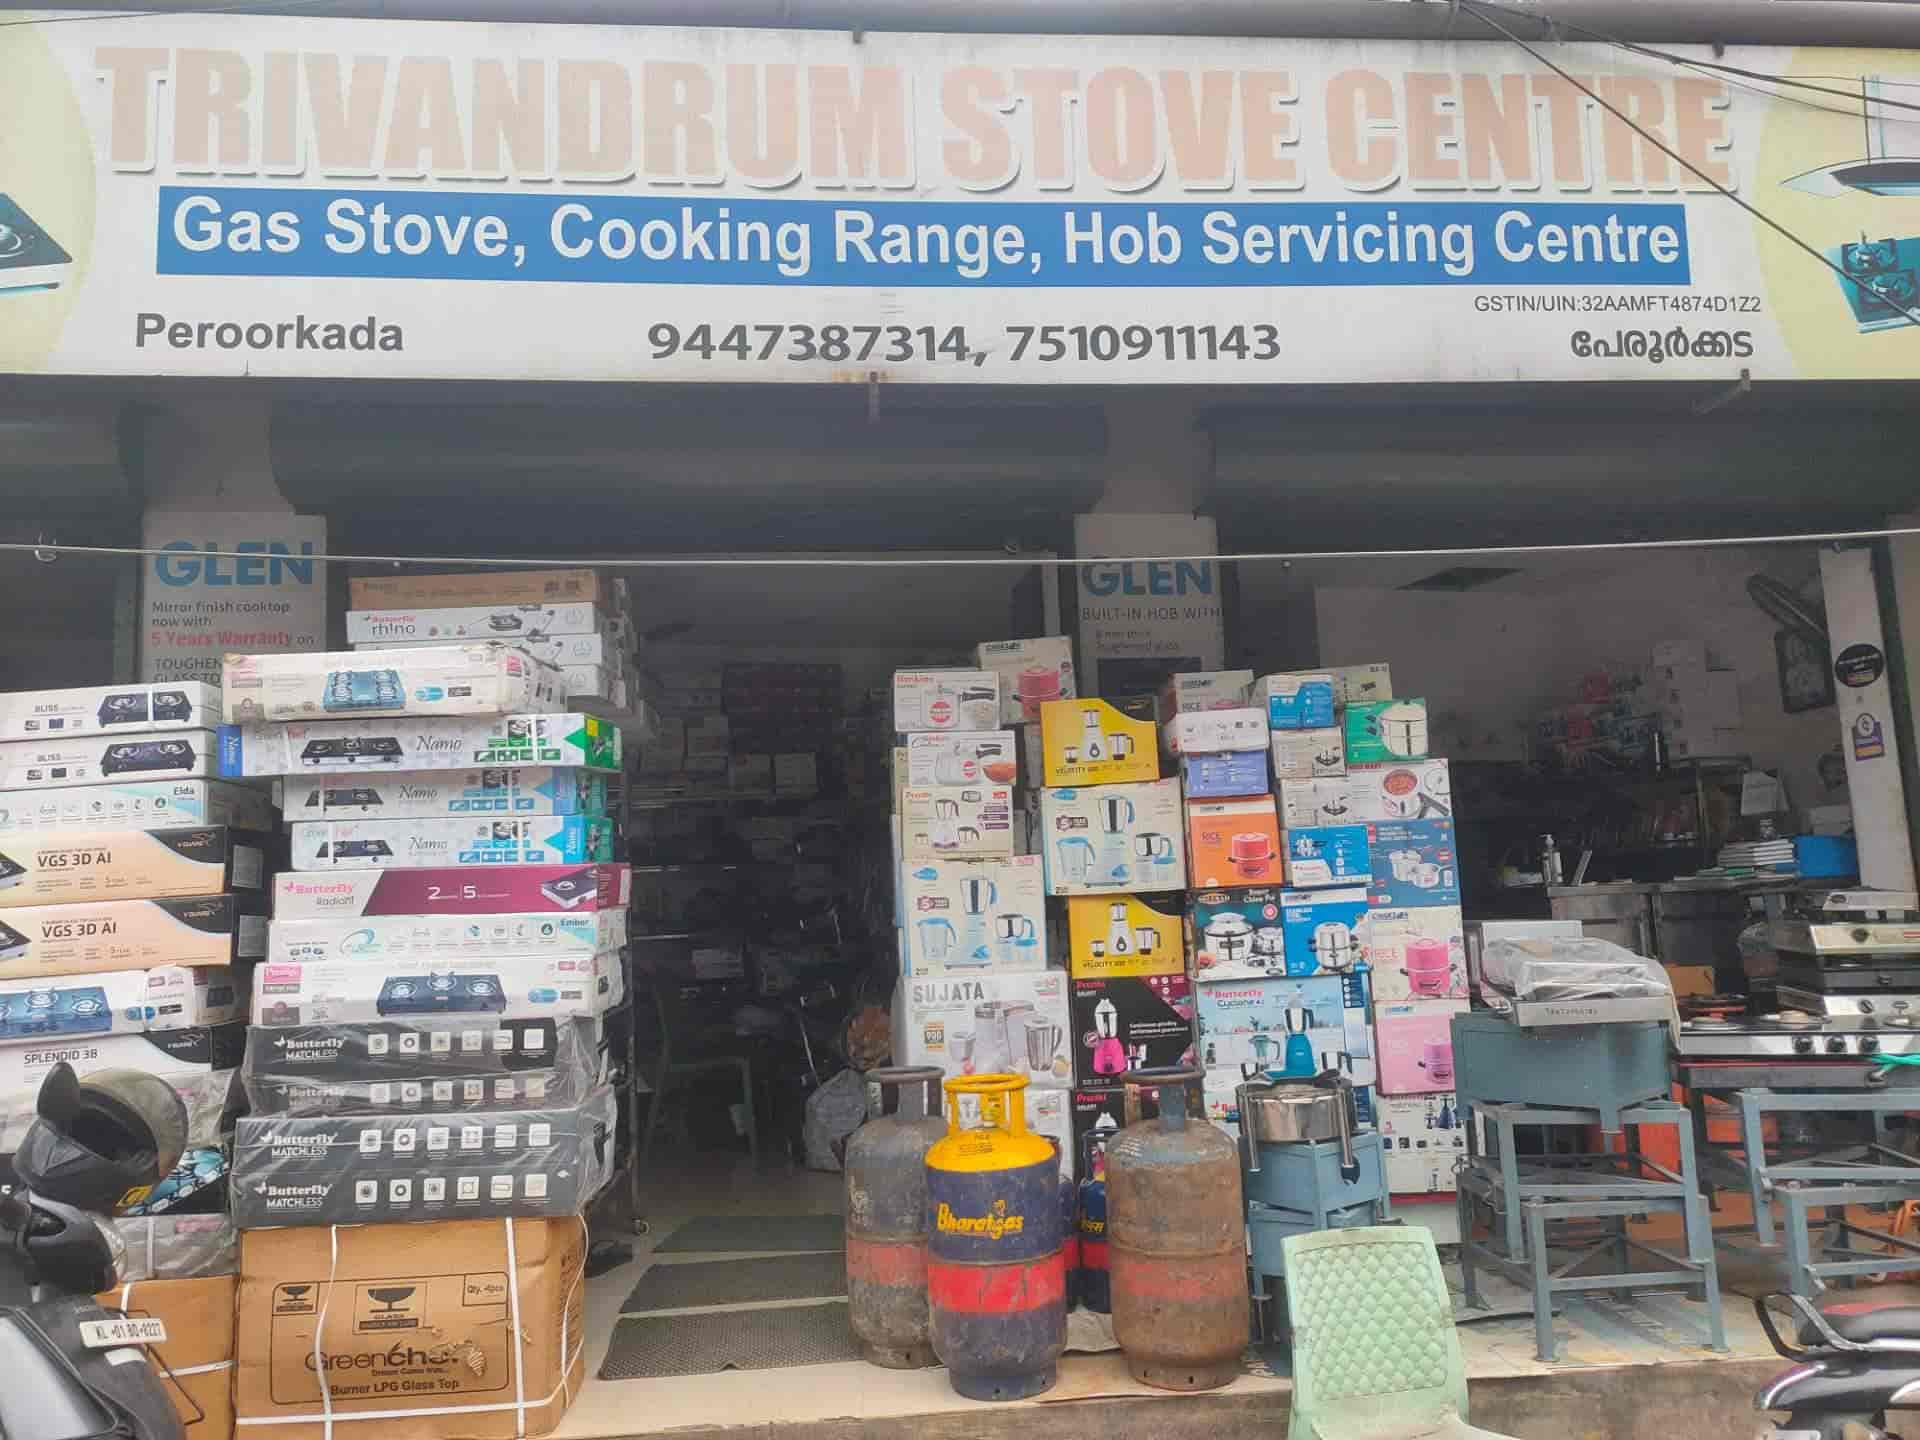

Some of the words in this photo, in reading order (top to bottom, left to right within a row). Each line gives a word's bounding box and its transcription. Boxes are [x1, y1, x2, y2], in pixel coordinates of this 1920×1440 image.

[95, 46, 918, 190] TRIVANDRUM
[940, 62, 1306, 193] STOVE
[1325, 66, 1740, 195] CENTRE
[172, 196, 301, 254] Gas
[324, 199, 527, 267] Stove,
[549, 203, 812, 276] Cooking
[834, 207, 1043, 281] Range,
[1064, 210, 1182, 264] Hob
[1202, 209, 1475, 277] Servicing
[1493, 208, 1680, 266] Centre
[1474, 294, 1762, 314] GSTIN/UIN:32AAMFT4874D1Z2
[135, 313, 404, 352] Peroorkada
[647, 322, 986, 366] 9447387314,
[1006, 325, 1281, 361] 7510911143
[155, 540, 313, 587] GLEN
[1082, 555, 1212, 596] GLEN
[152, 601, 192, 613] Mirror
[196, 600, 233, 613] finish
[235, 601, 291, 615] cooktop
[1082, 608, 1142, 620] BUILT-IN
[1148, 607, 1178, 620] HOB
[371, 620, 416, 636] rhino
[166, 631, 214, 646] Years
[218, 631, 292, 650] Warranty
[297, 635, 314, 646] on
[416, 734, 462, 751] Namo
[398, 783, 440, 800] Namo
[408, 836, 448, 850] Namo
[37, 855, 67, 868] VGS
[72, 853, 91, 866] 3D
[96, 852, 112, 864] AI
[428, 886, 441, 900] 2
[463, 885, 476, 899] 5
[41, 924, 73, 938] VGS
[77, 923, 97, 936] 3D
[101, 922, 117, 935] AI
[913, 982, 985, 1003] SUJATA
[286, 1036, 346, 1050] Butterfly
[24, 1050, 80, 1065] SPLENDID
[82, 1048, 98, 1060] 3B
[286, 1050, 338, 1061] MATCHLESS
[273, 1132, 338, 1146] Butterfly
[271, 1147, 328, 1158] MATCHLESS
[267, 1183, 333, 1197] Butterfly
[266, 1197, 323, 1209] MATCHLESS
[936, 1201, 1025, 1240] Bharatgas
[330, 1384, 370, 1396] Burner
[374, 1382, 399, 1393] LPG
[400, 1380, 435, 1392] Glass
[438, 1379, 460, 1391] Top
